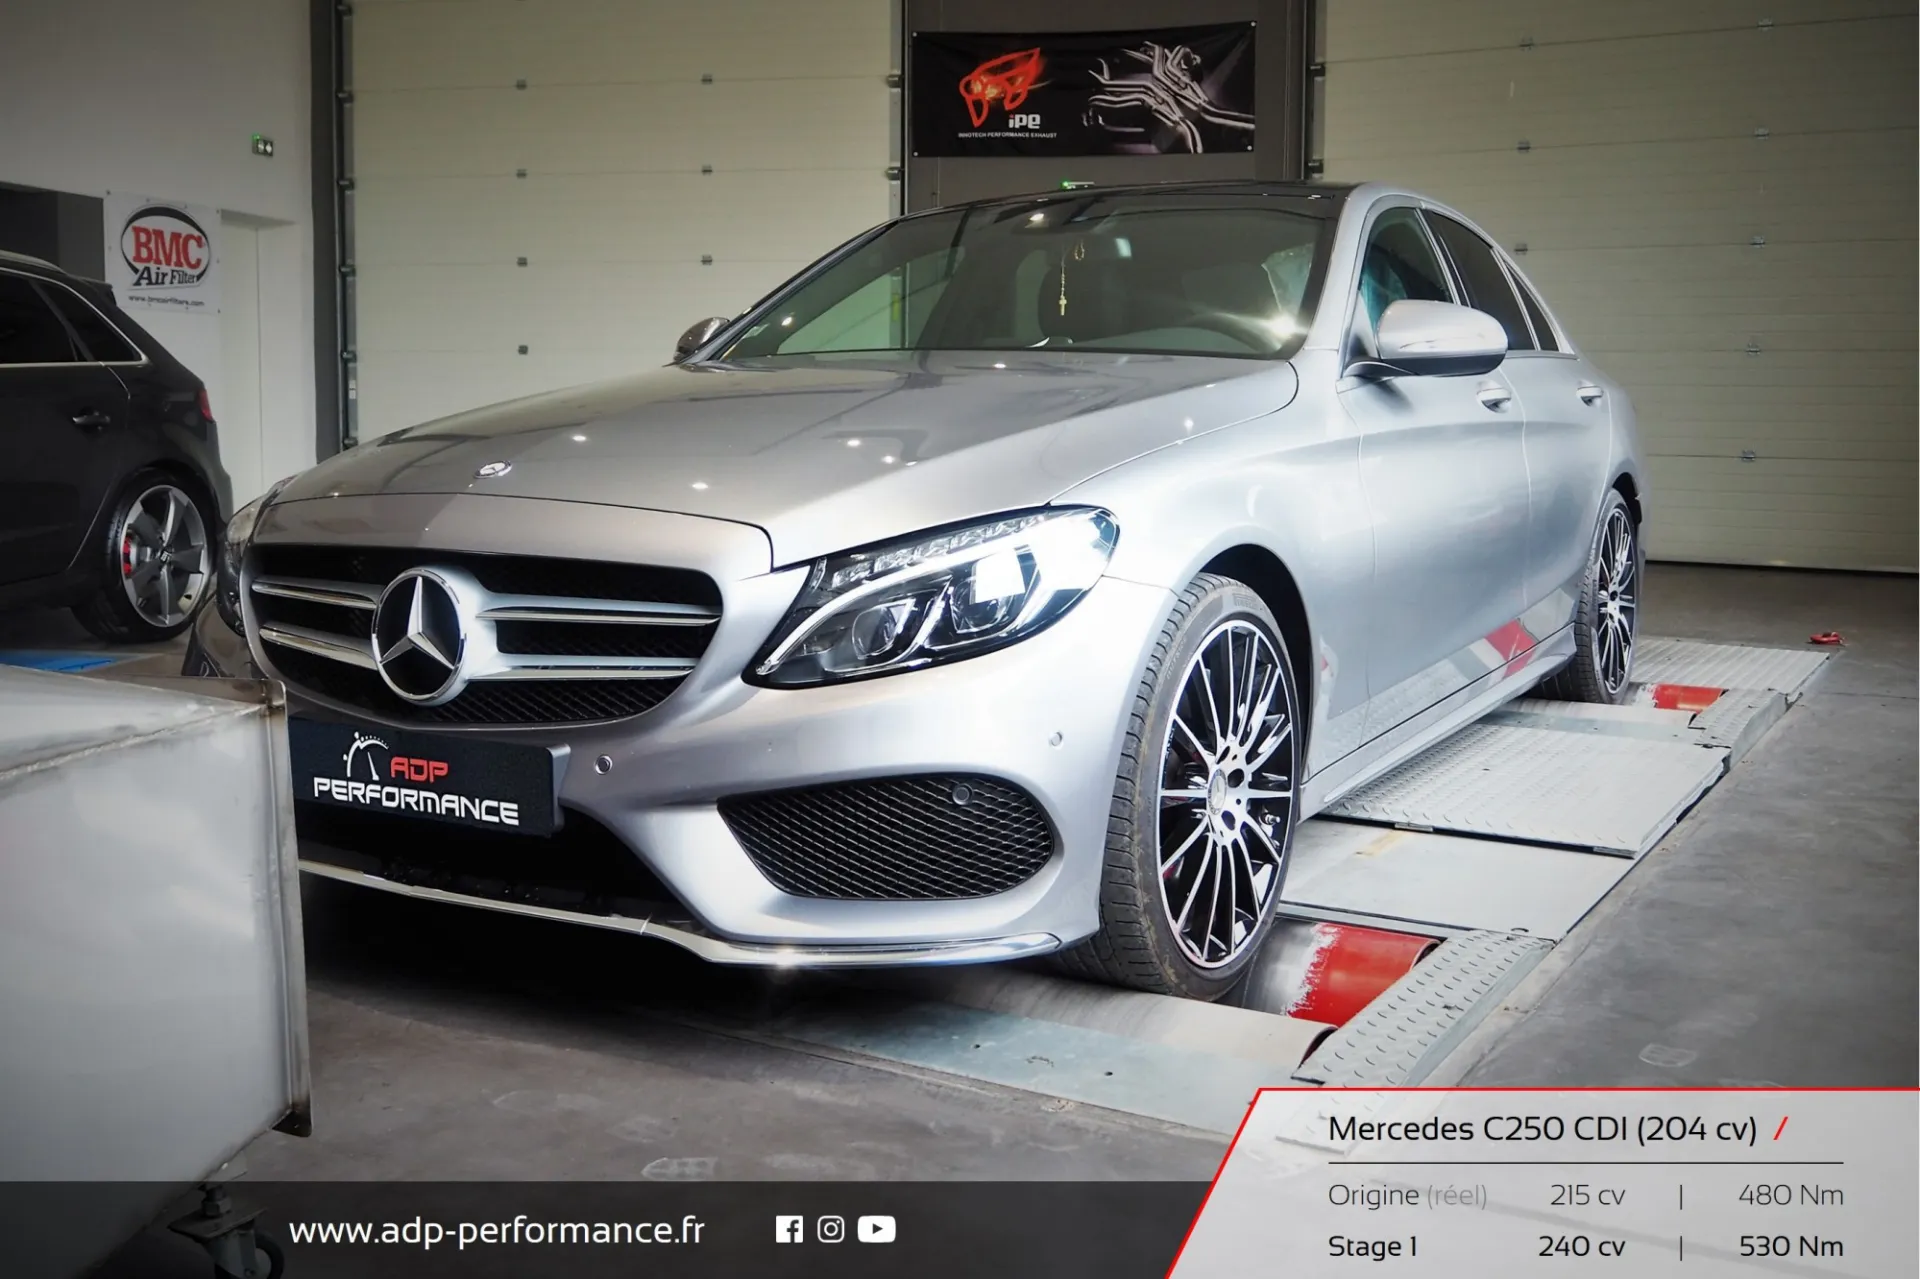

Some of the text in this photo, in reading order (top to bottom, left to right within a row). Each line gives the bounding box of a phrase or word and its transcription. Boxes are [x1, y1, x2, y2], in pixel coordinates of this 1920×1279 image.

[987, 131, 1029, 139] PERFORMANCE
[131, 225, 204, 270] BMC
[133, 266, 197, 287] Air Filter
[390, 756, 449, 784] ADP
[313, 776, 520, 827] PERFORMANCE
